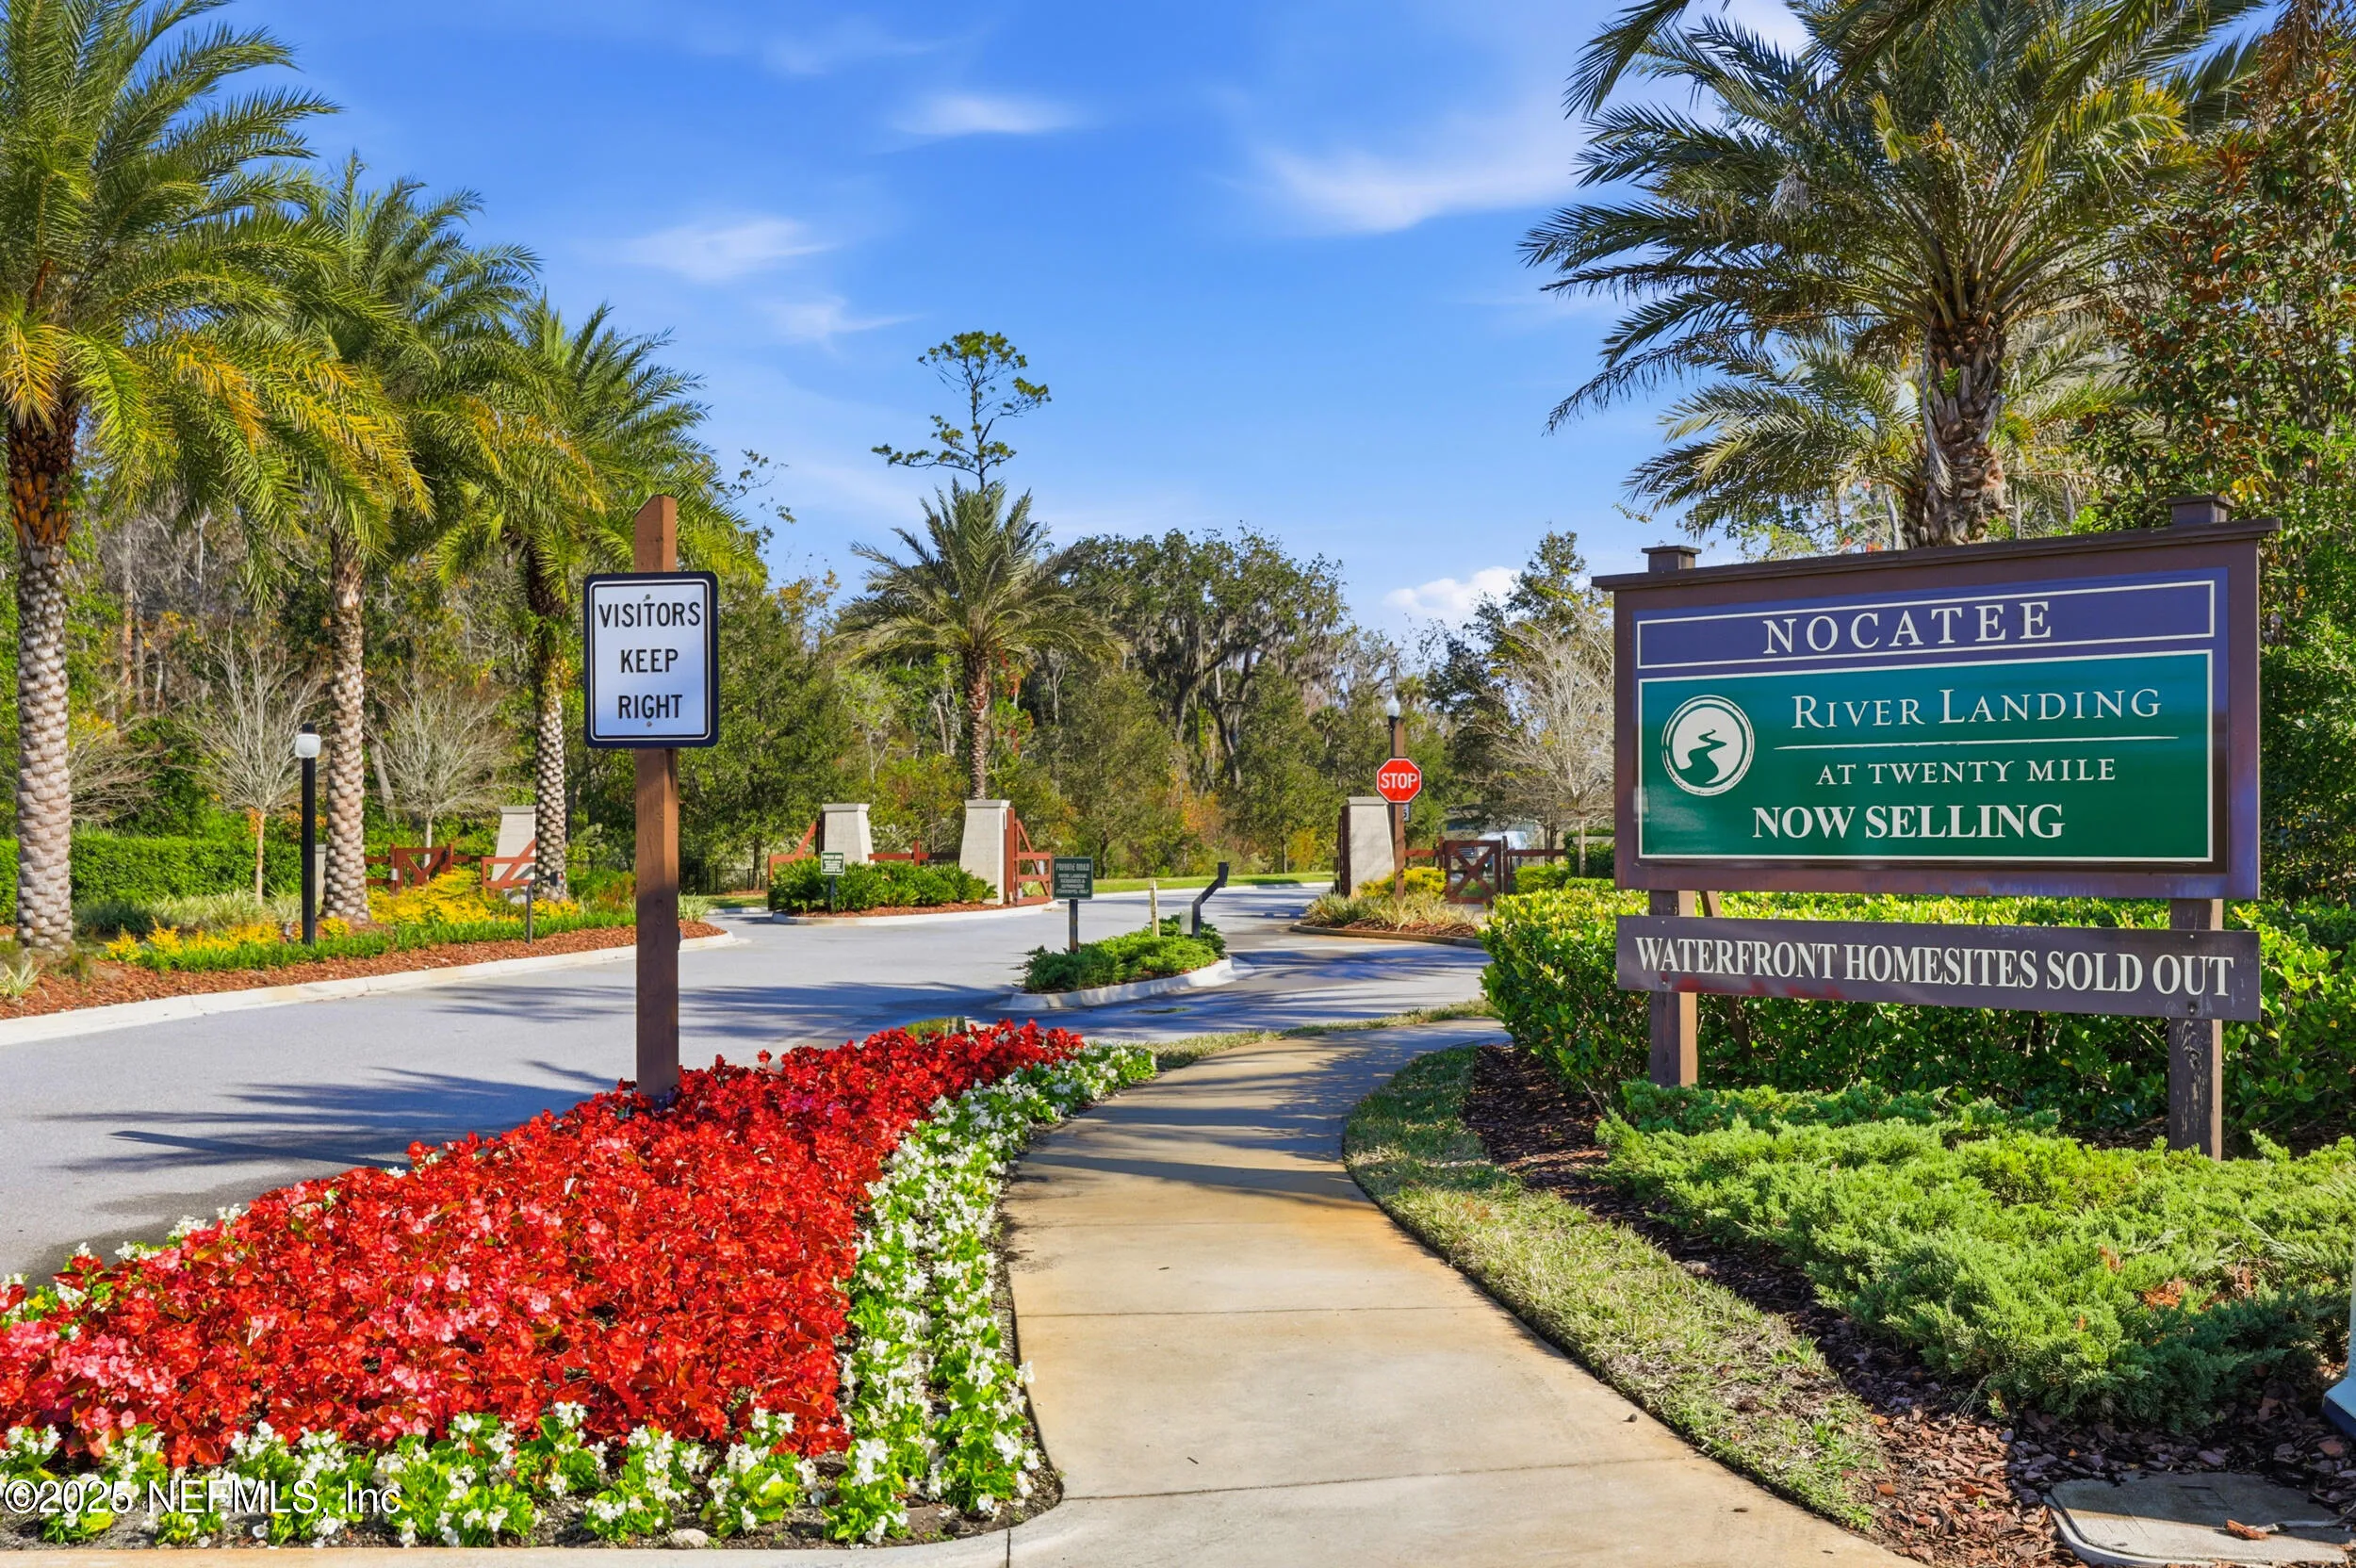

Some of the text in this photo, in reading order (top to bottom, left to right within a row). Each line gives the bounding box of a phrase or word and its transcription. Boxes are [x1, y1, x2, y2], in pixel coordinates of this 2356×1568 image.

[597, 601, 701, 629] VISITORS
[1762, 600, 2053, 654] NOCATEE
[620, 648, 679, 674] KEEP
[618, 694, 683, 720] RIGHT
[1791, 688, 2163, 729] RIVER LANDING
[1380, 772, 1418, 790] STOP
[1815, 758, 2117, 786] AT TWENTY MILE
[1752, 803, 2066, 840] NOW SELLING
[1634, 937, 2235, 997] WATERFRONT HOMESITES SOLD OUT
